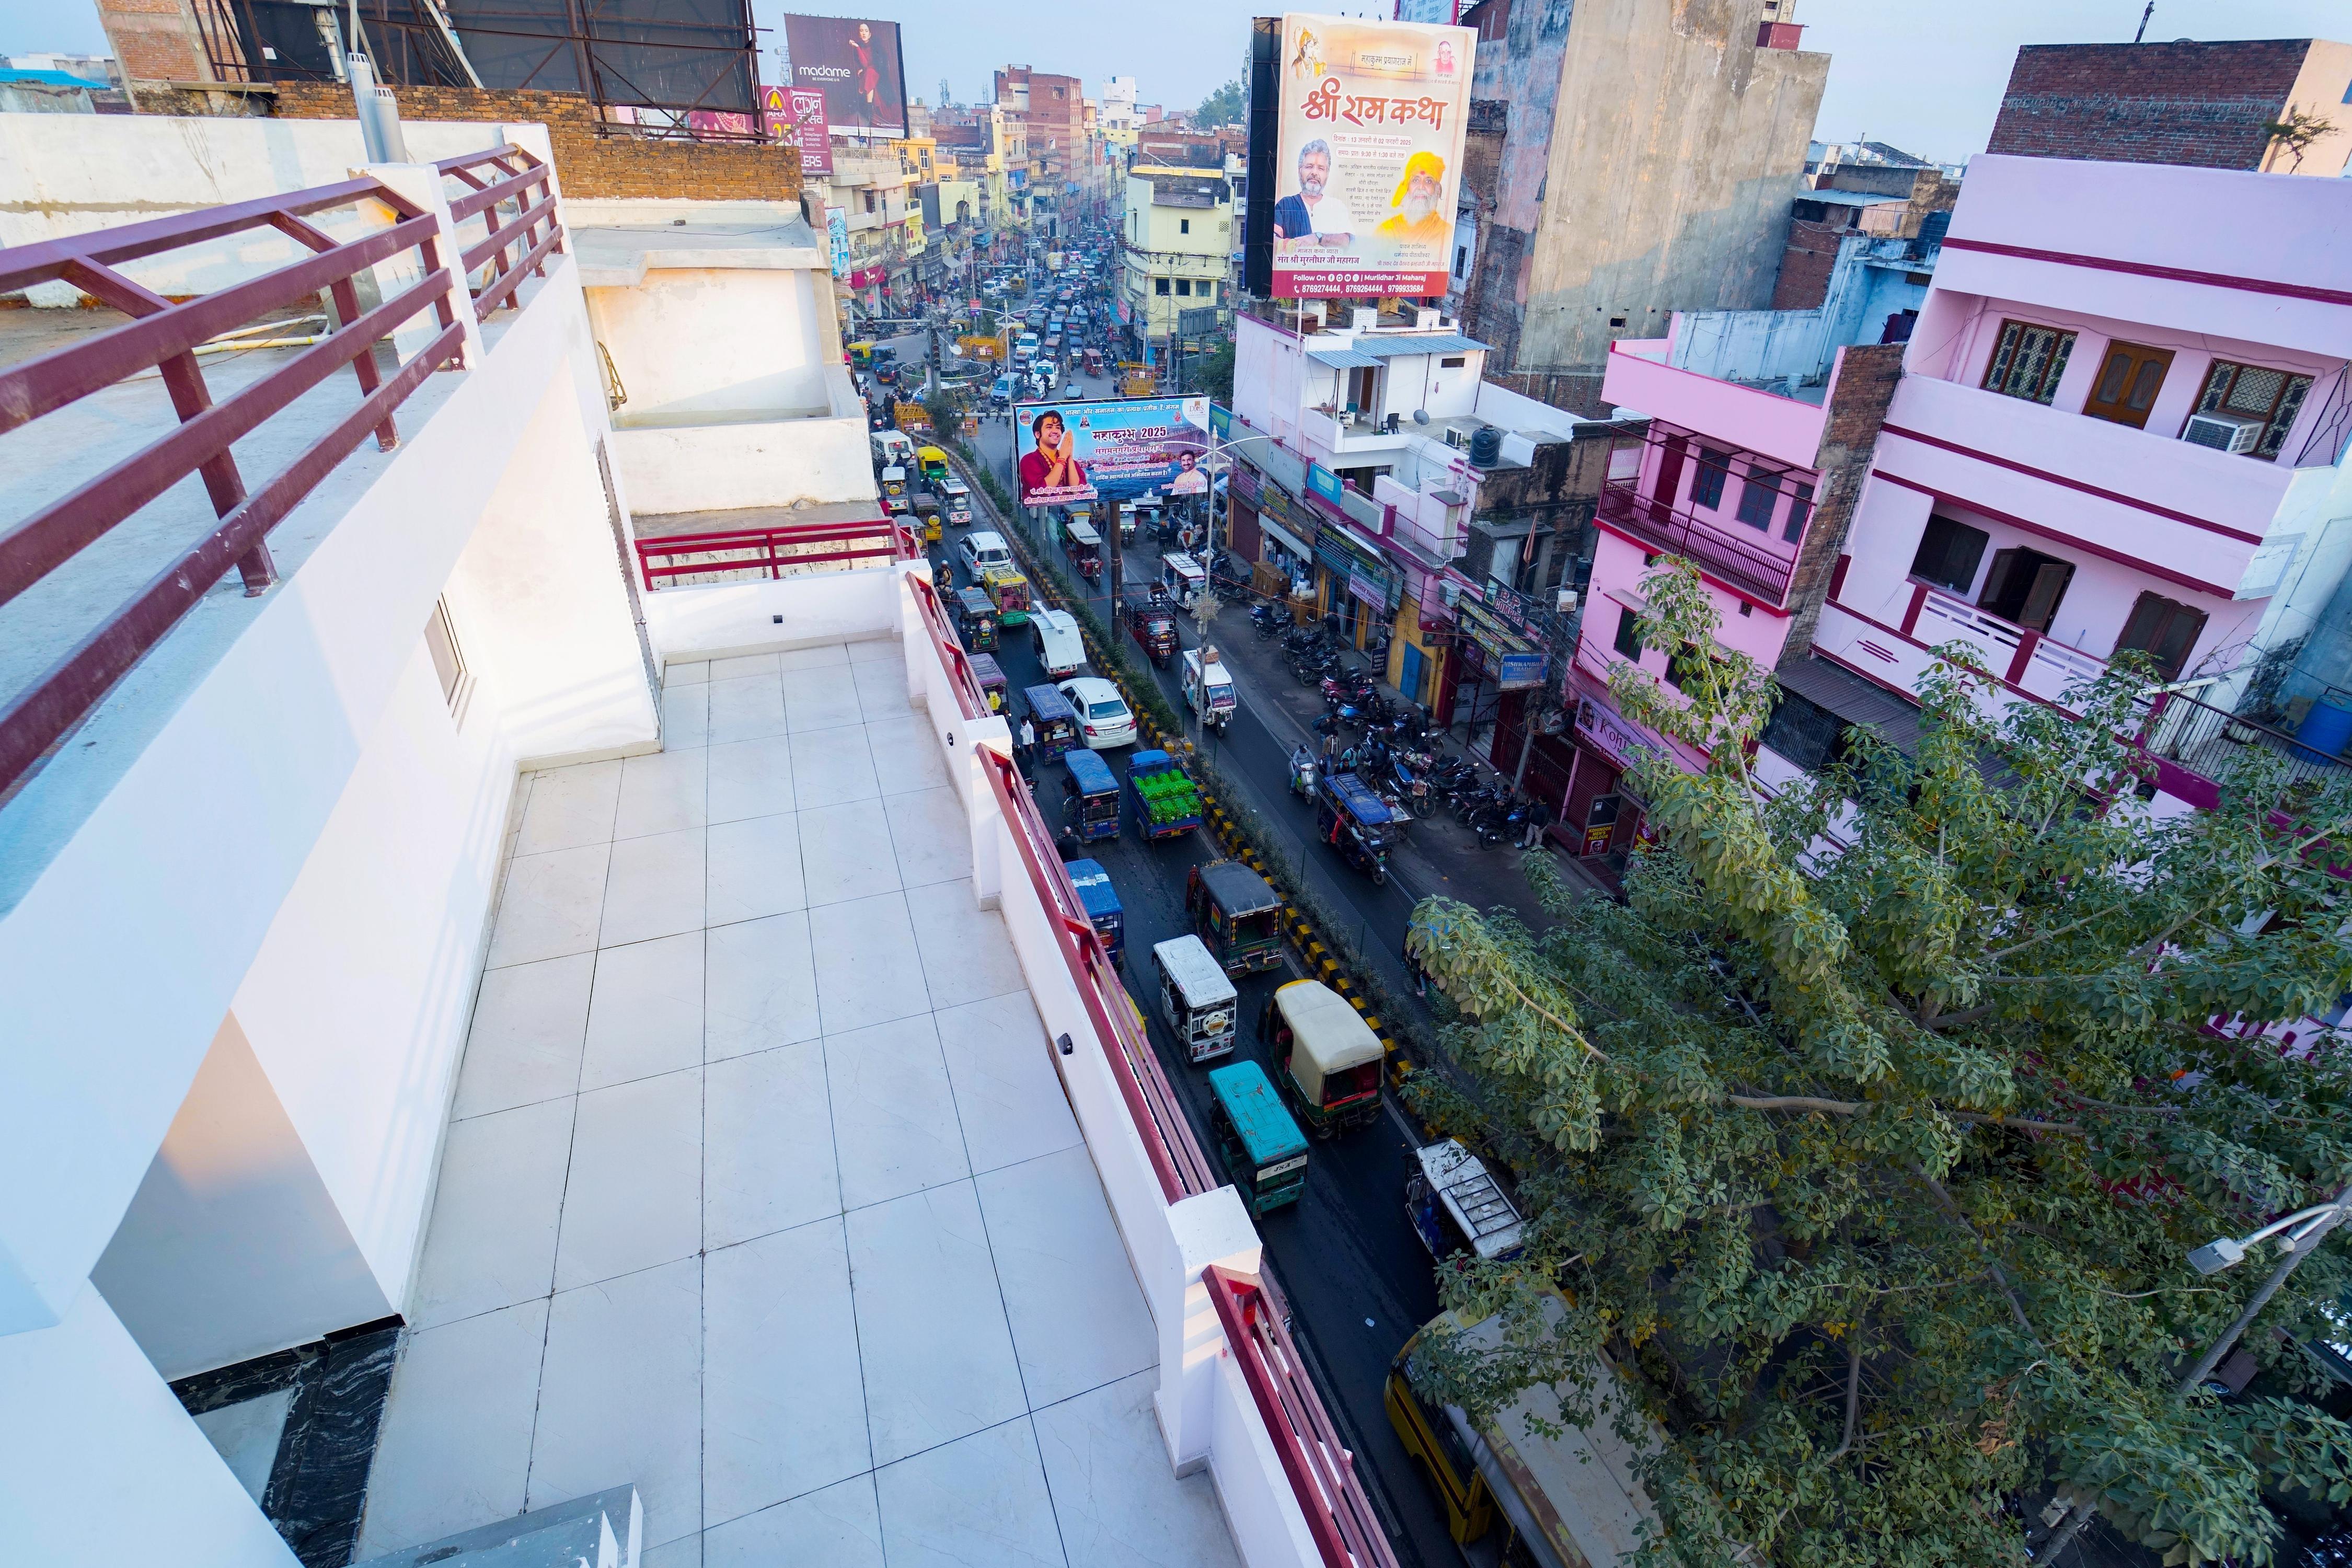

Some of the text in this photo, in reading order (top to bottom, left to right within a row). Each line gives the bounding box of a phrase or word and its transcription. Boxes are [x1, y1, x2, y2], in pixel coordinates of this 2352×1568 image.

[1361, 55, 1382, 66] महाकुम्भ
[1383, 56, 1406, 66] प्रयागराज
[799, 65, 850, 77] madame
[1300, 77, 1448, 131] श्री राम कथा
[794, 137, 803, 147] off
[1277, 254, 1289, 264] संत
[1300, 255, 1325, 266] मुरलीधर
[1327, 255, 1335, 263] जी
[1302, 285, 1343, 294] 8769274444,
[1345, 285, 1385, 294] 8769264444,
[1092, 427, 1167, 444] महाकुम्भ 2025
[1094, 444, 1165, 456] संगमनगरी प्रयागराज
[1321, 526, 1333, 538] SHREE
[1351, 579, 1367, 594] ABHISHEK
[1366, 590, 1384, 606] PHARMACY
[1494, 598, 1525, 628] COMPLEX
[1584, 735, 1602, 752] Shahganj,
[1602, 749, 1617, 763] Leader
[1274, 1162, 1291, 1171] JSA
